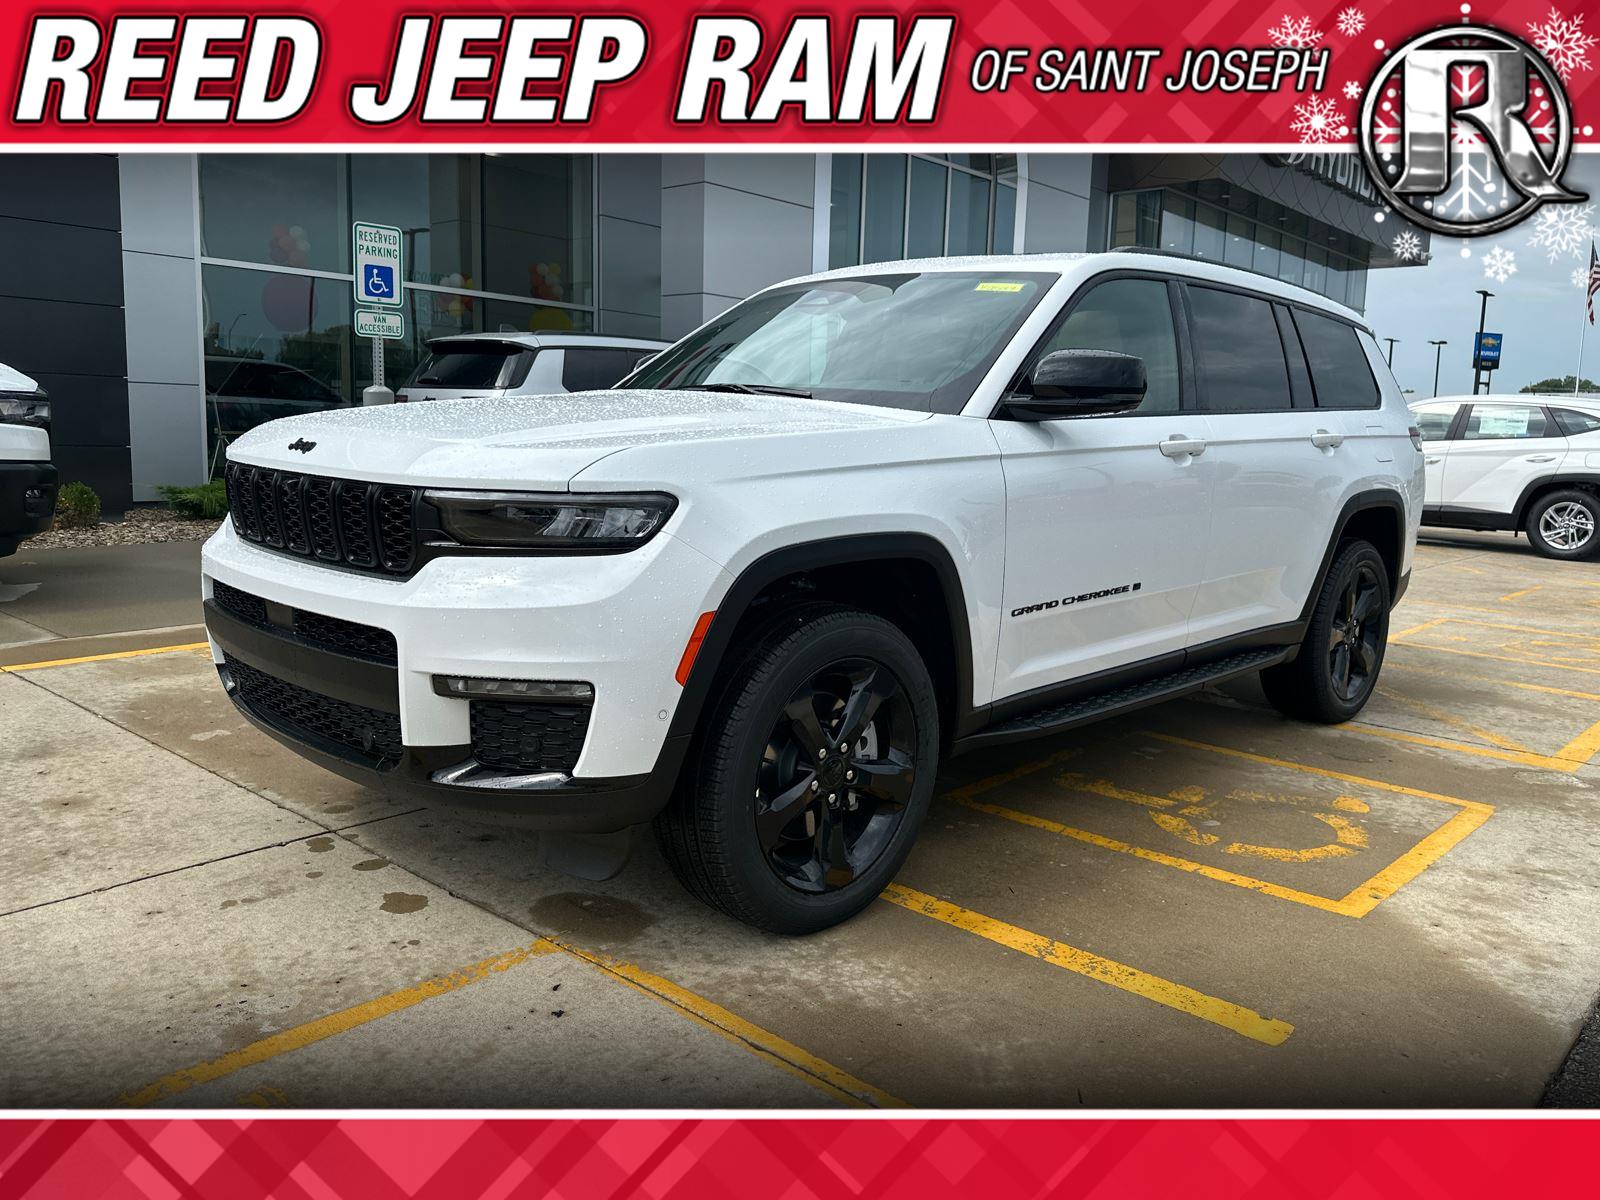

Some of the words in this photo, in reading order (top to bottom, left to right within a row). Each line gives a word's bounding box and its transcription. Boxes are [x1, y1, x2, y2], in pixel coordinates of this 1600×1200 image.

[359, 231, 397, 246] RESERVED
[358, 244, 398, 259] PARKING
[373, 315, 386, 323] VAN
[359, 323, 400, 334] ACCESSIBLE
[1011, 599, 1060, 618] GRAND
[1061, 584, 1131, 606] CHEROKEE
